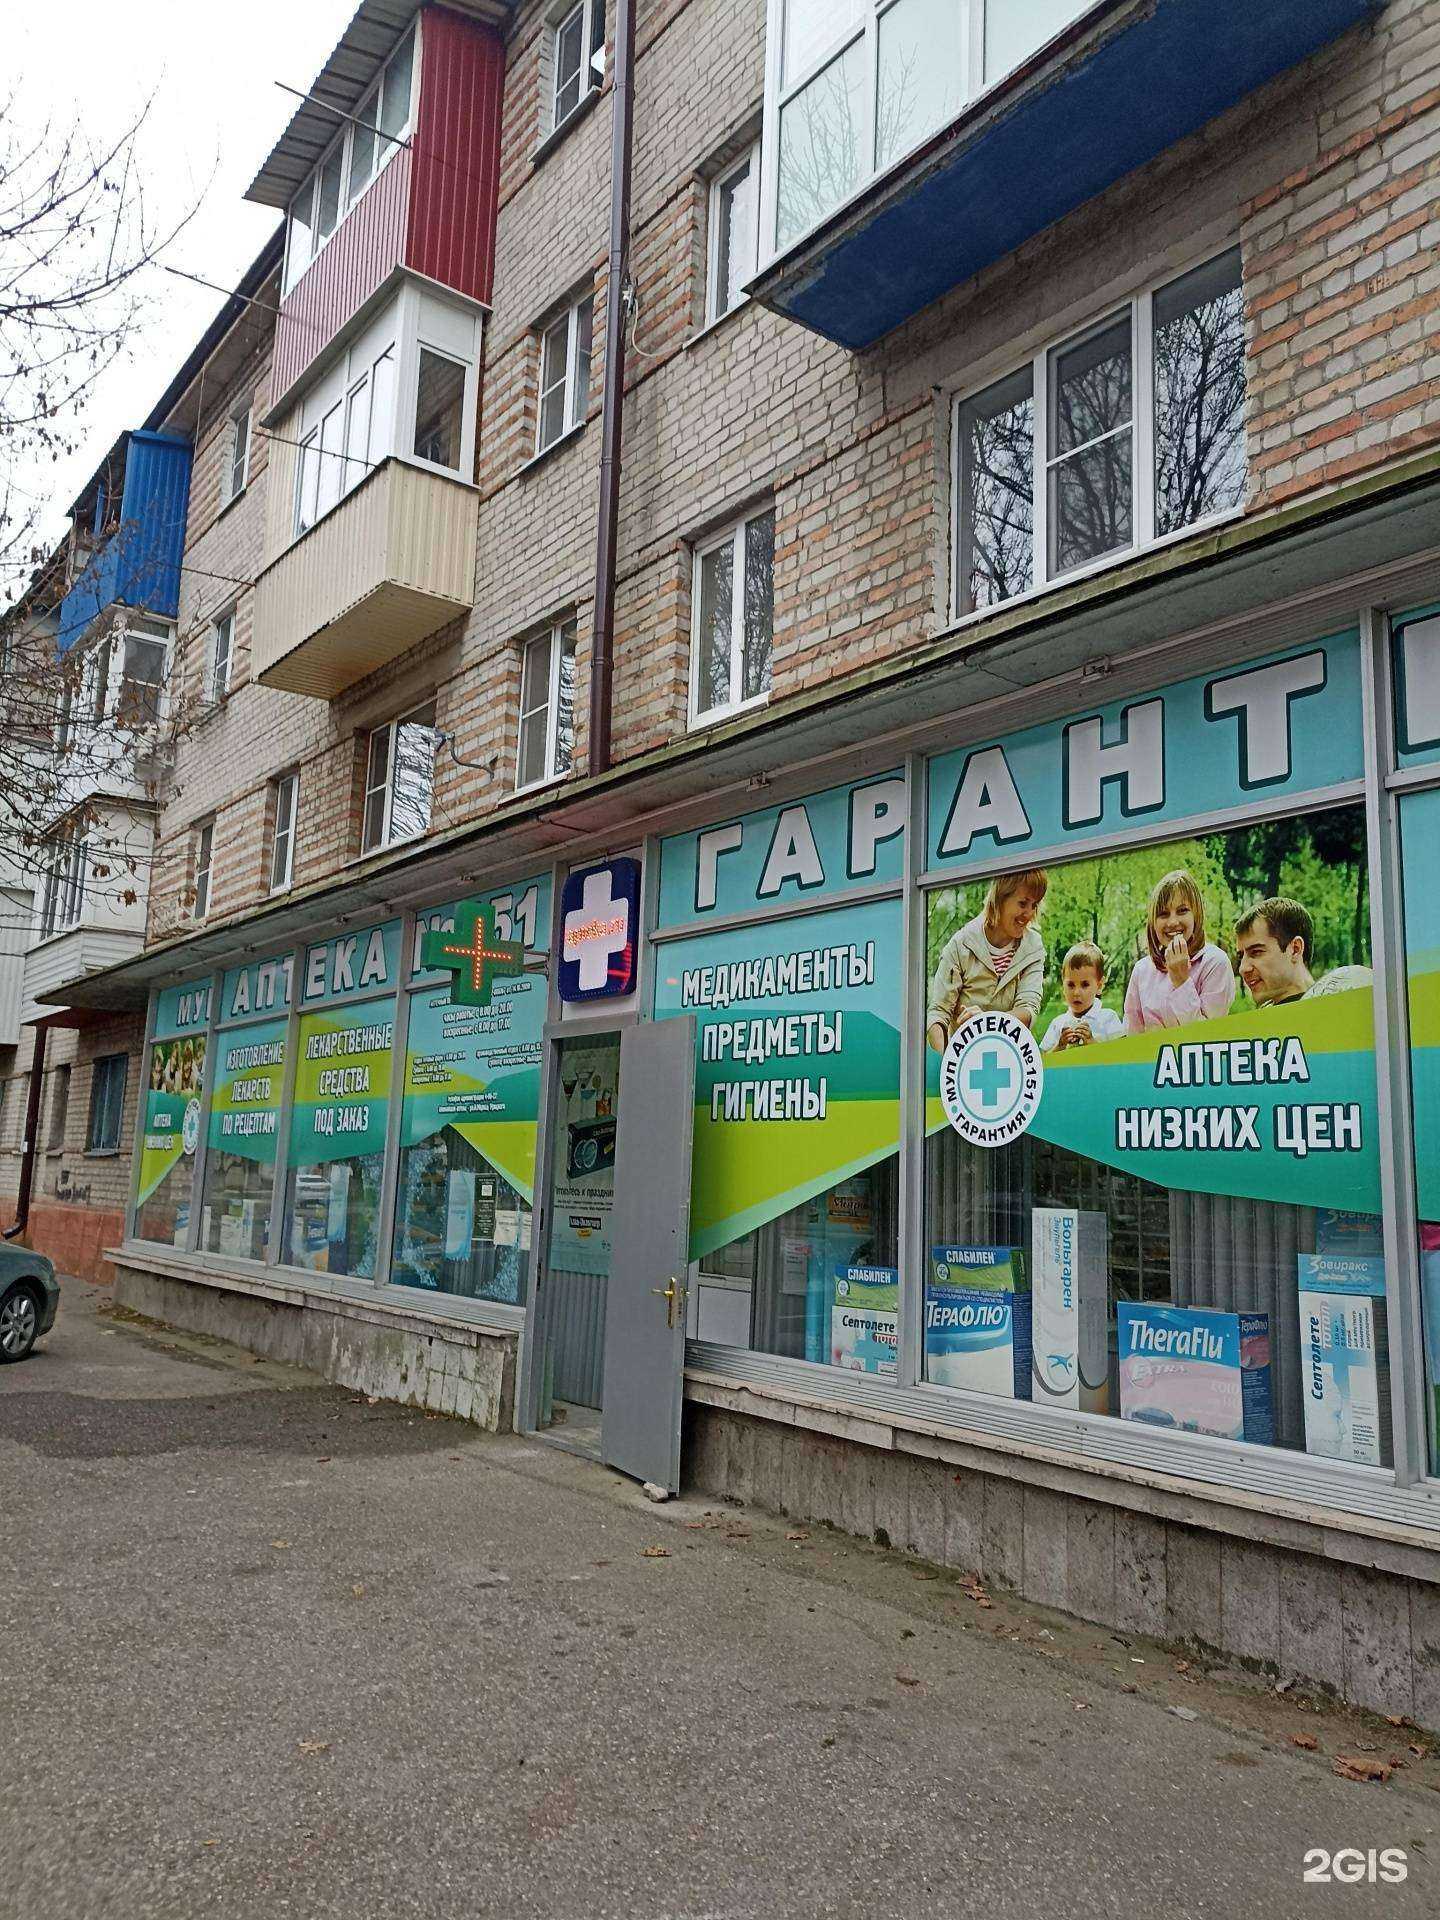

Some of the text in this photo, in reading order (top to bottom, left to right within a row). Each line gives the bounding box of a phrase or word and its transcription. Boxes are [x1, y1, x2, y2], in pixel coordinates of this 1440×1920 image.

[231, 929, 387, 1016] АПТЕКА
[681, 941, 875, 1009] МЕДИКАМЕНТЫ
[306, 1022, 392, 1060] ЛЕКАРСТВЕННЫЕ
[702, 1011, 843, 1064] ПРЕДМЕТЫ
[226, 1041, 284, 1071] ИЗГОТОВЛЕНИЕ
[946, 1061, 957, 1102] МУП
[952, 1016, 1021, 1057] АПТЕКА
[1154, 1035, 1310, 1087] АПТЕКА
[231, 1076, 271, 1102] ЛЕКАРСТВ
[319, 1065, 369, 1098] СРЕДСТВА
[711, 1077, 827, 1121] ГИГИЕНЫ
[222, 1113, 233, 1136] ПО
[234, 1111, 275, 1138] РЕЦЕПТАМ
[314, 1106, 369, 1136] ПОД ЗАКАЗ
[955, 1110, 1027, 1141] ГАРАНТИЯ
[1115, 1101, 1362, 1155] НИЗКИХ ЦЕН
[946, 1250, 994, 1264] СЛАБИЛЕН
[1061, 1216, 1075, 1309] Вольтарен
[1306, 1254, 1368, 1274] Зовиракс
[848, 1268, 891, 1284] СЛАБИЛЕН
[842, 1314, 895, 1333] Септолете
[926, 1301, 1003, 1328] ТЕРАФЛЮ
[1128, 1319, 1223, 1359] TheraFlu
[1310, 1316, 1324, 1400] Септолете
